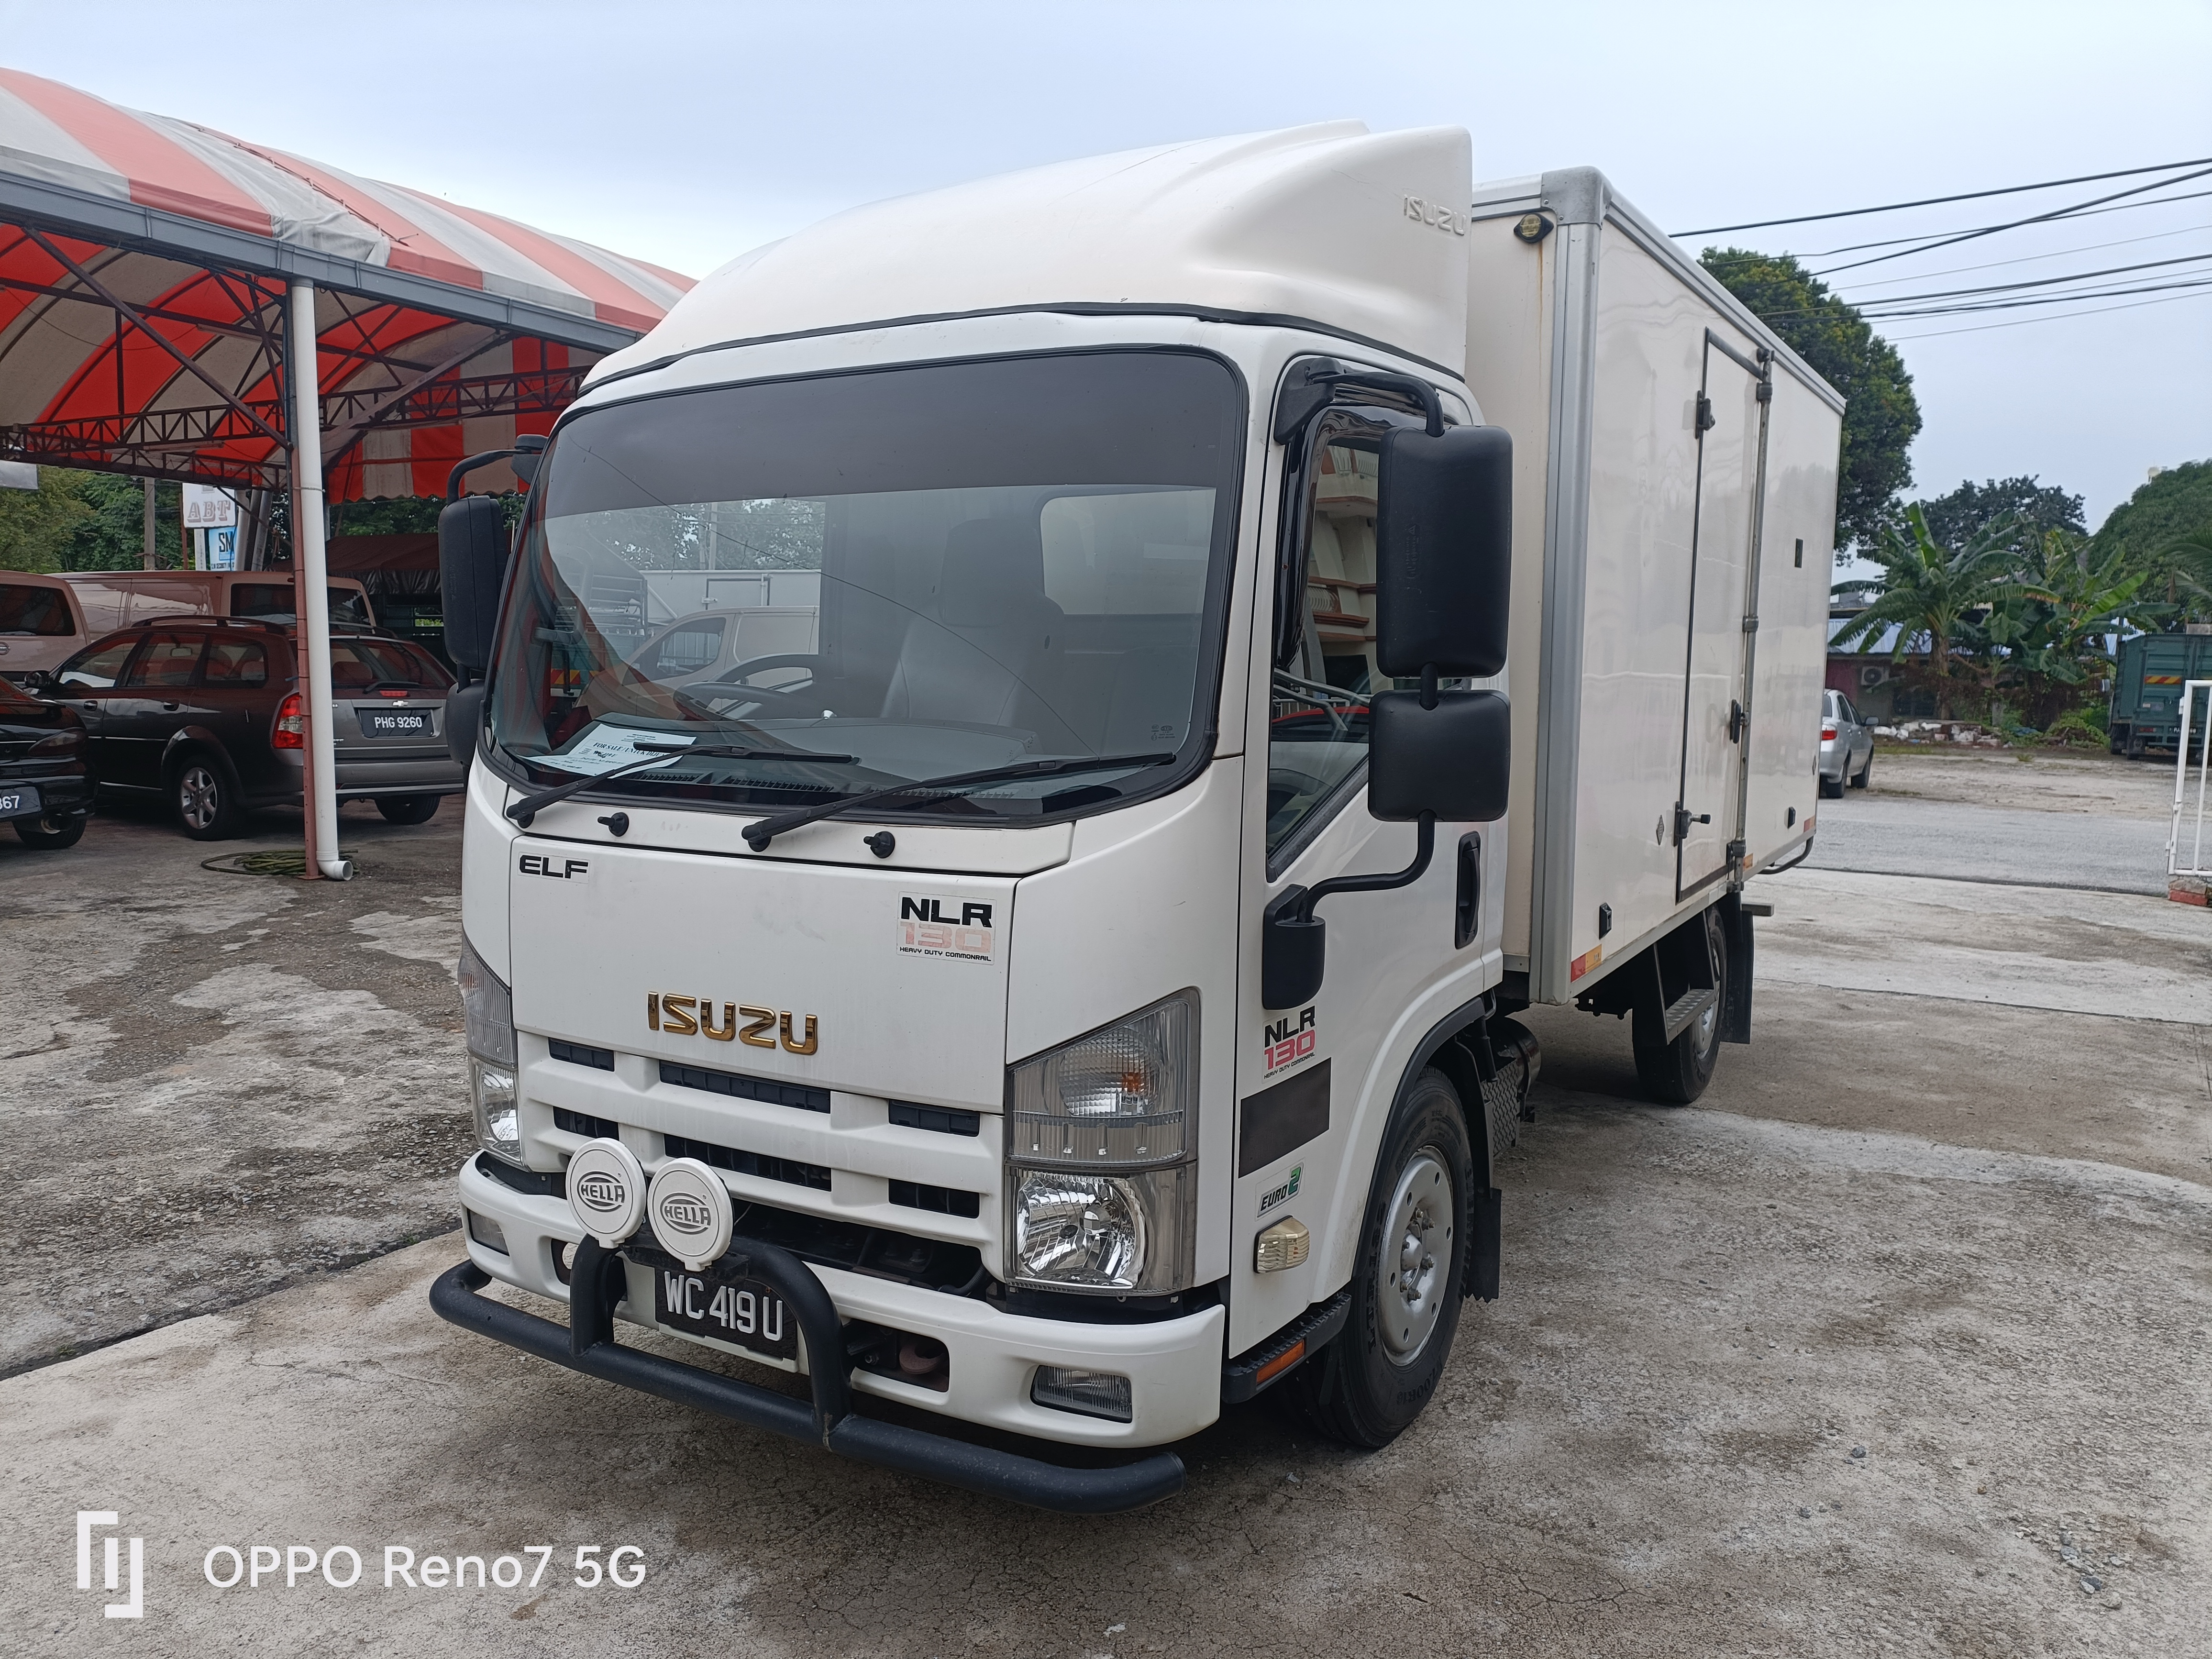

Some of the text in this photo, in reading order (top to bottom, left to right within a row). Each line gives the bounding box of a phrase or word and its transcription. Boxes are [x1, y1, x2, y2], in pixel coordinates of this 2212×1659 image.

[1404, 194, 1466, 236] ISUZU
[187, 500, 231, 523] ABT
[219, 531, 234, 552] SM
[375, 717, 422, 729] PHG 9260
[520, 854, 588, 879] ELF
[901, 897, 992, 928] NLR
[900, 921, 991, 953] 130
[945, 951, 992, 962] COMMONRAIL
[648, 991, 818, 1056] ISUZU
[1264, 1006, 1316, 1048] NLR
[1264, 1029, 1316, 1070] 130
[1264, 1051, 1316, 1080] HEAVY DUTY COMMONRAIL
[580, 1183, 625, 1203] HELLA
[664, 1205, 711, 1226] HELLA
